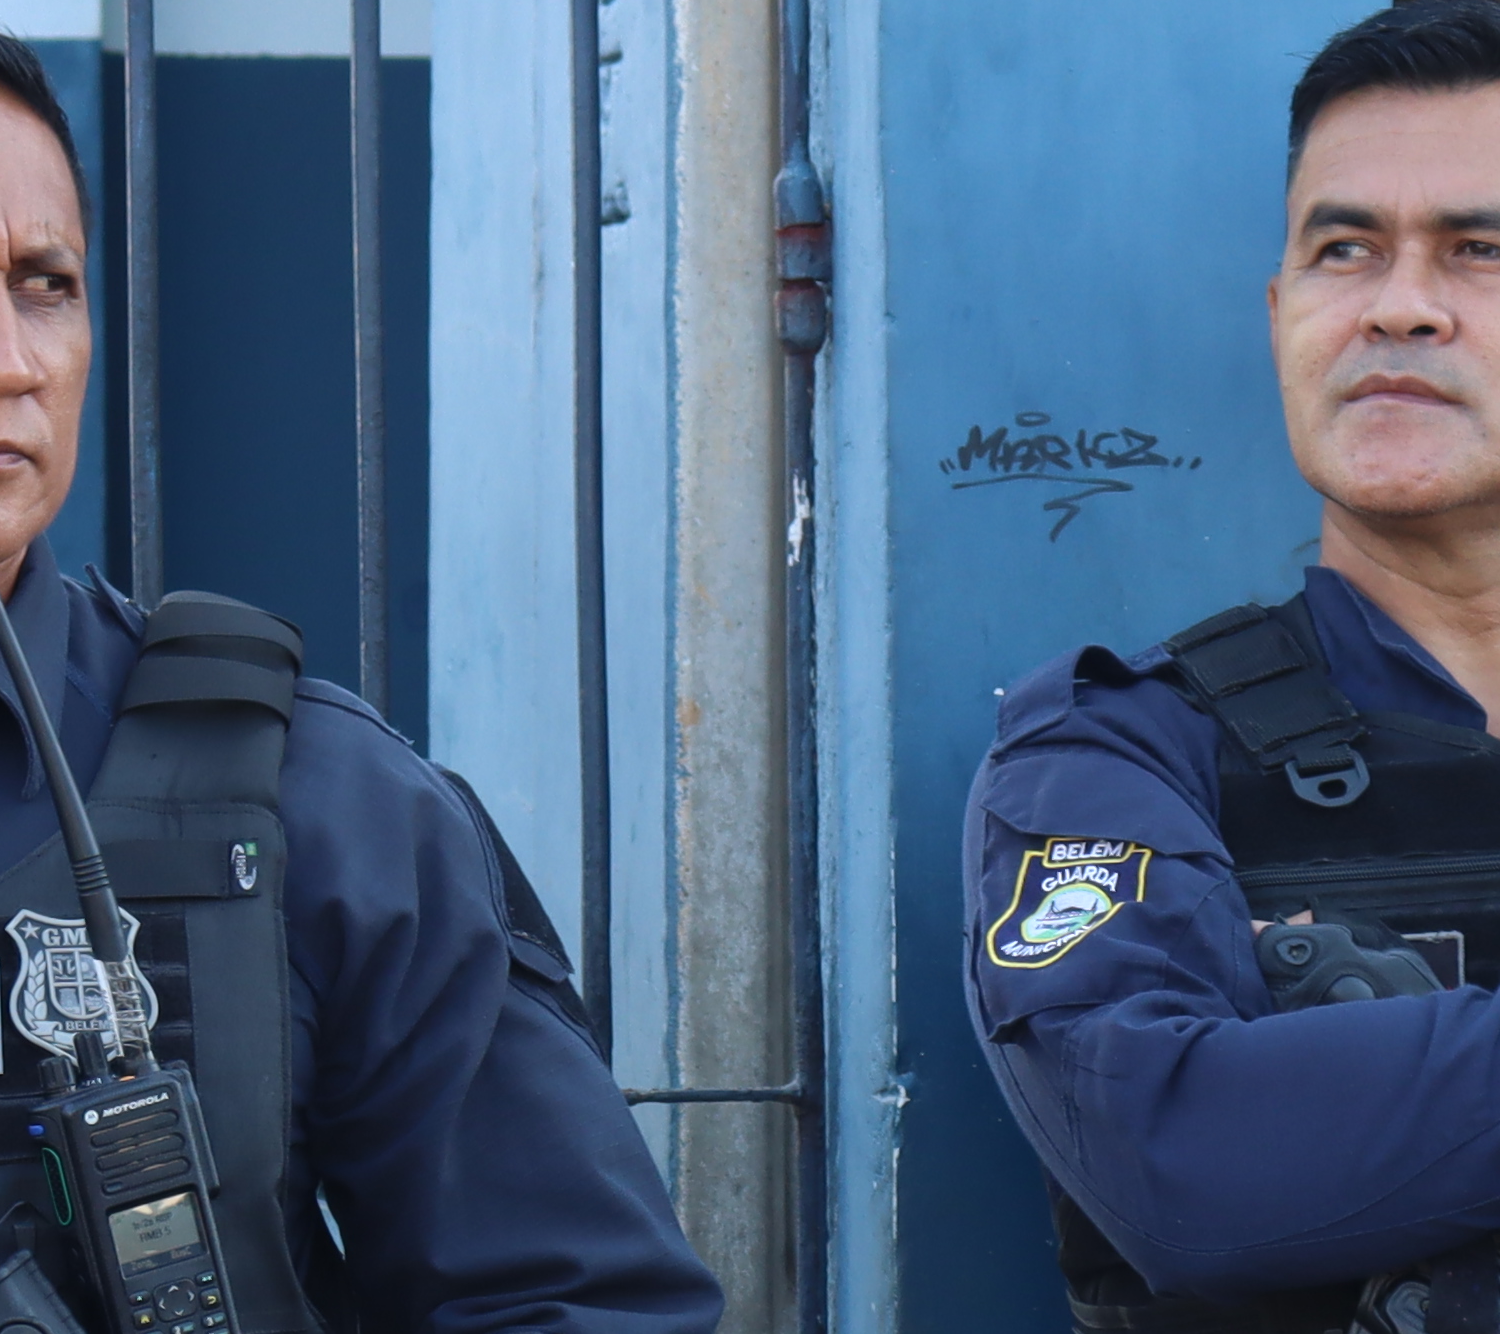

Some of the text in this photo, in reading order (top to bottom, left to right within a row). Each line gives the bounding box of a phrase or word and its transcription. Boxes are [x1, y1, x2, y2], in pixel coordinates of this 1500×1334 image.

[1052, 839, 1125, 862] BELÉM
[1041, 865, 1120, 893] GUARDA
[41, 928, 92, 947] GM
[102, 1092, 170, 1118] MOTOROLA
